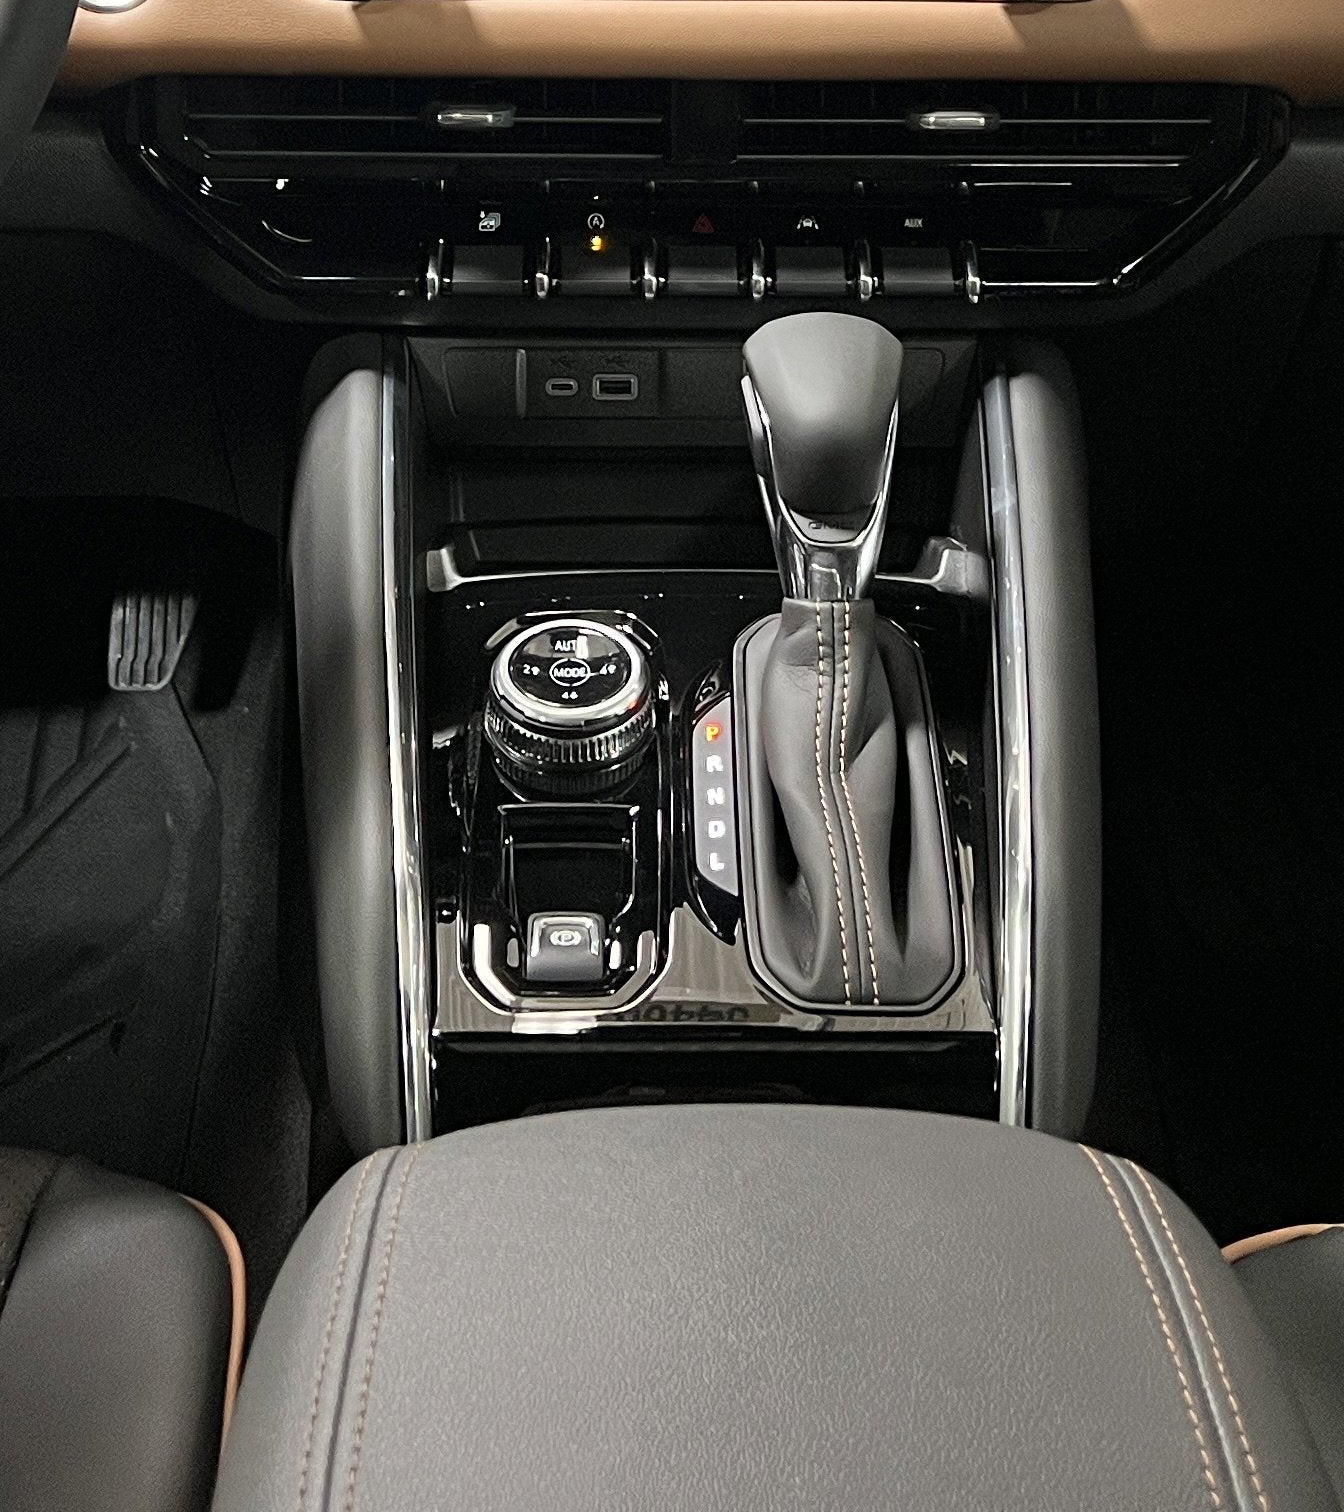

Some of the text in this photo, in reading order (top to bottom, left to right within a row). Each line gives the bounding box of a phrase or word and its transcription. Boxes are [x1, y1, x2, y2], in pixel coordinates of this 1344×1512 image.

[903, 218, 924, 228] AUX
[552, 666, 588, 678] MODE
[705, 724, 720, 742] P
[706, 754, 724, 773] R
[706, 786, 726, 806] N
[708, 819, 726, 839] D
[709, 852, 725, 871] L
